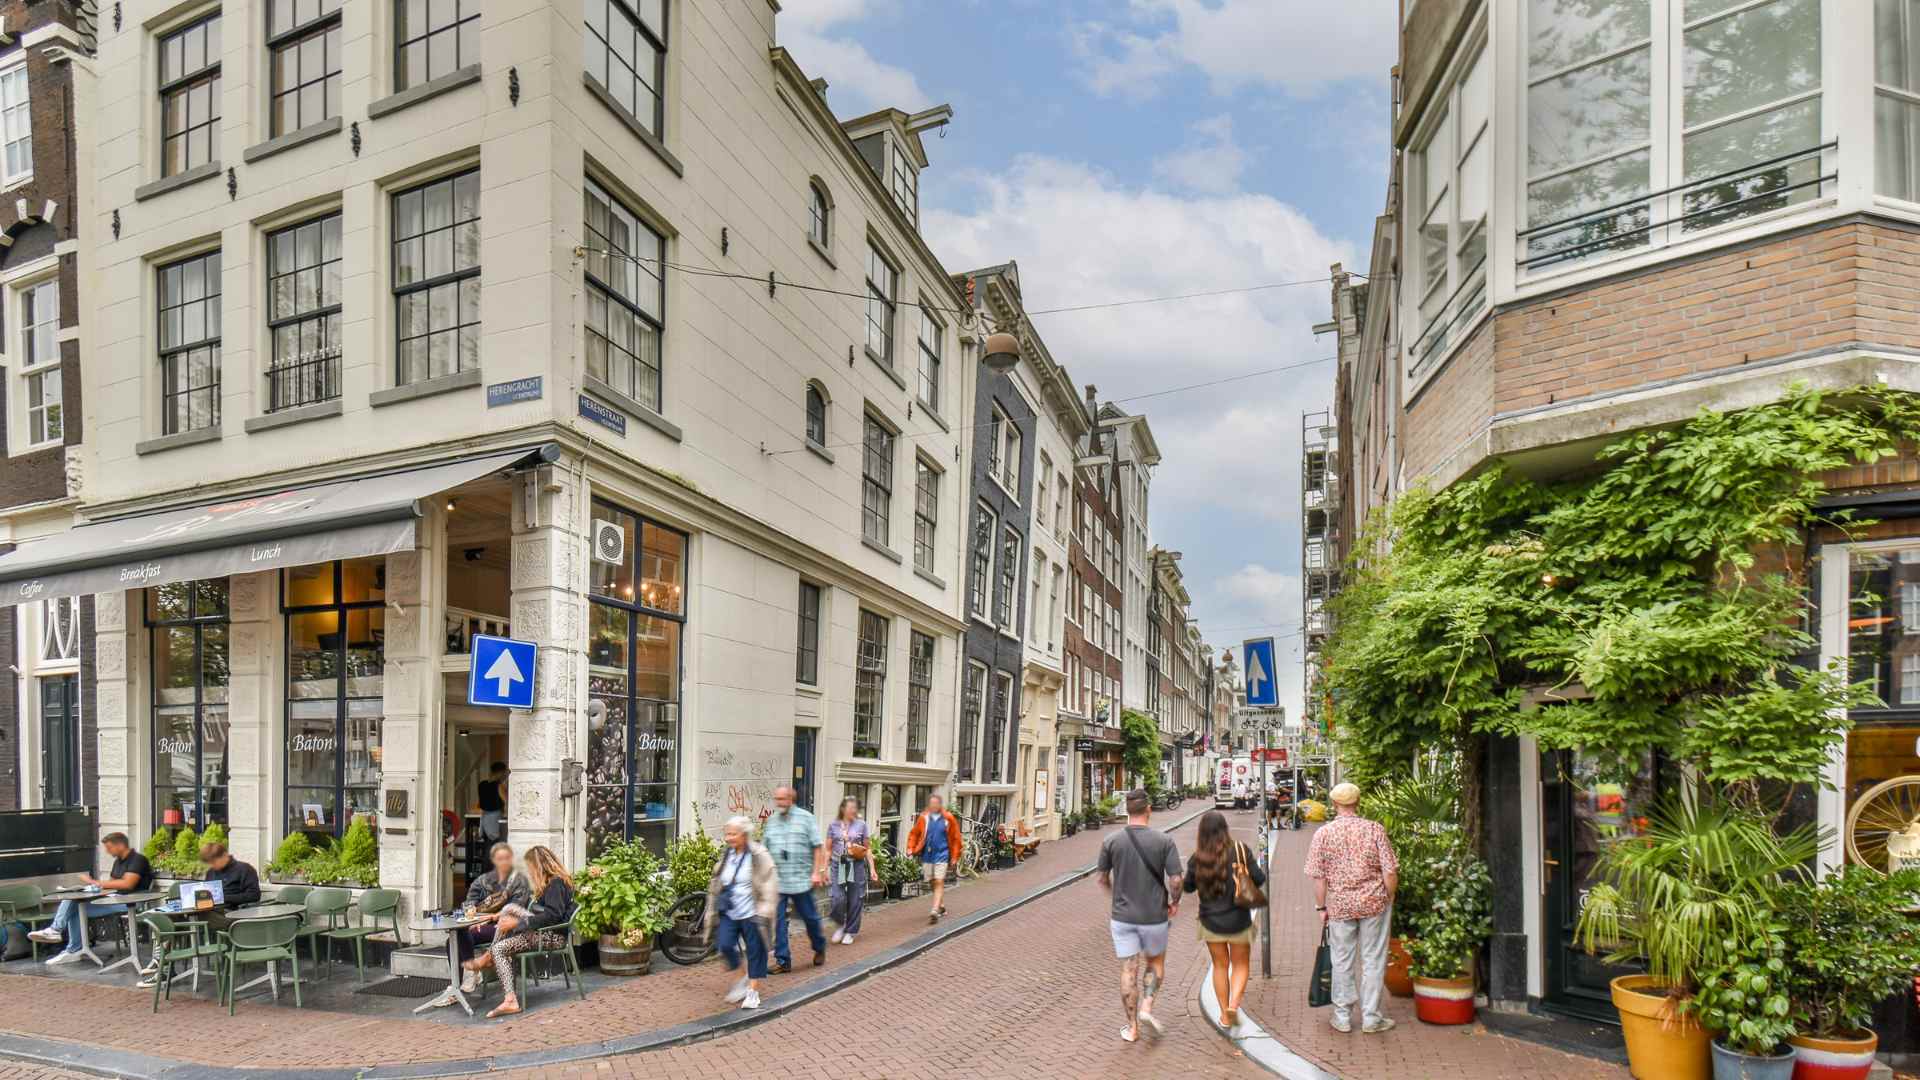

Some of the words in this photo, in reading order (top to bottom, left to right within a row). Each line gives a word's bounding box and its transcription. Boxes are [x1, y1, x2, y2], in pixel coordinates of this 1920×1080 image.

[489, 379, 538, 397] HERENGRACHT
[581, 399, 623, 425] HERENSTRAAT
[19, 580, 44, 596] Coffee
[120, 563, 161, 582] Breakfast
[251, 544, 281, 562] Lunch
[158, 737, 192, 753] Bâton
[293, 734, 333, 752] Bâton
[638, 732, 674, 752] Bâton
